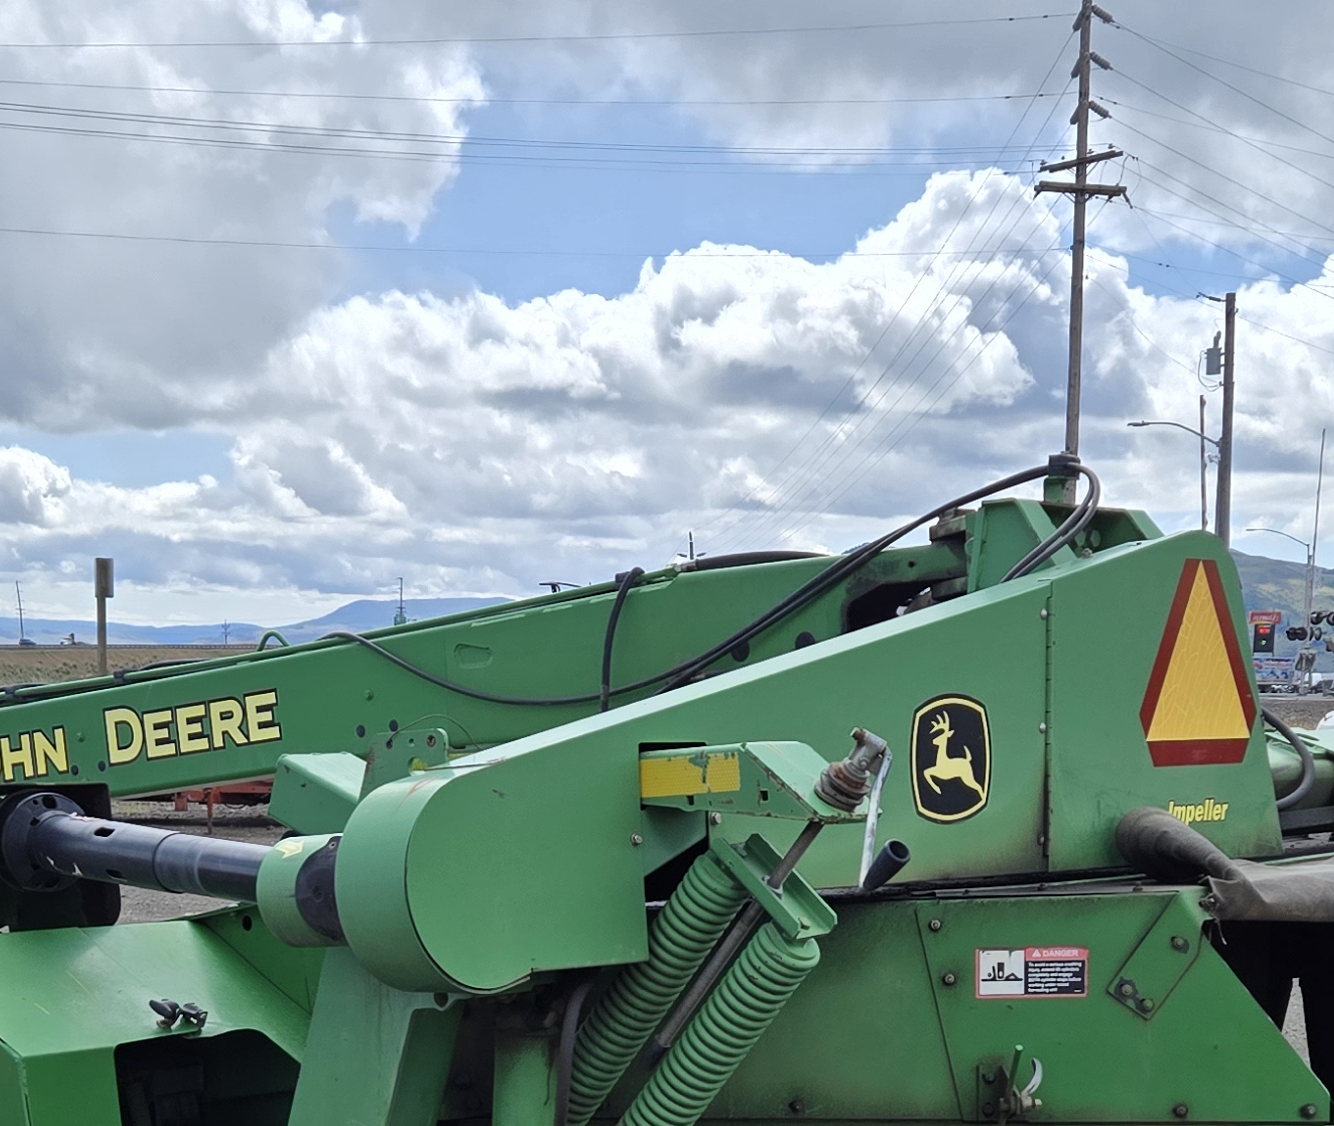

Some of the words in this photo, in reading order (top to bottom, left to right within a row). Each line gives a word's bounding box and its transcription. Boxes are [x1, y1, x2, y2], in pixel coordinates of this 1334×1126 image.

[102, 688, 283, 767] DEERE
[1168, 798, 1229, 826] Impeller
[1042, 949, 1079, 957] DANGER
